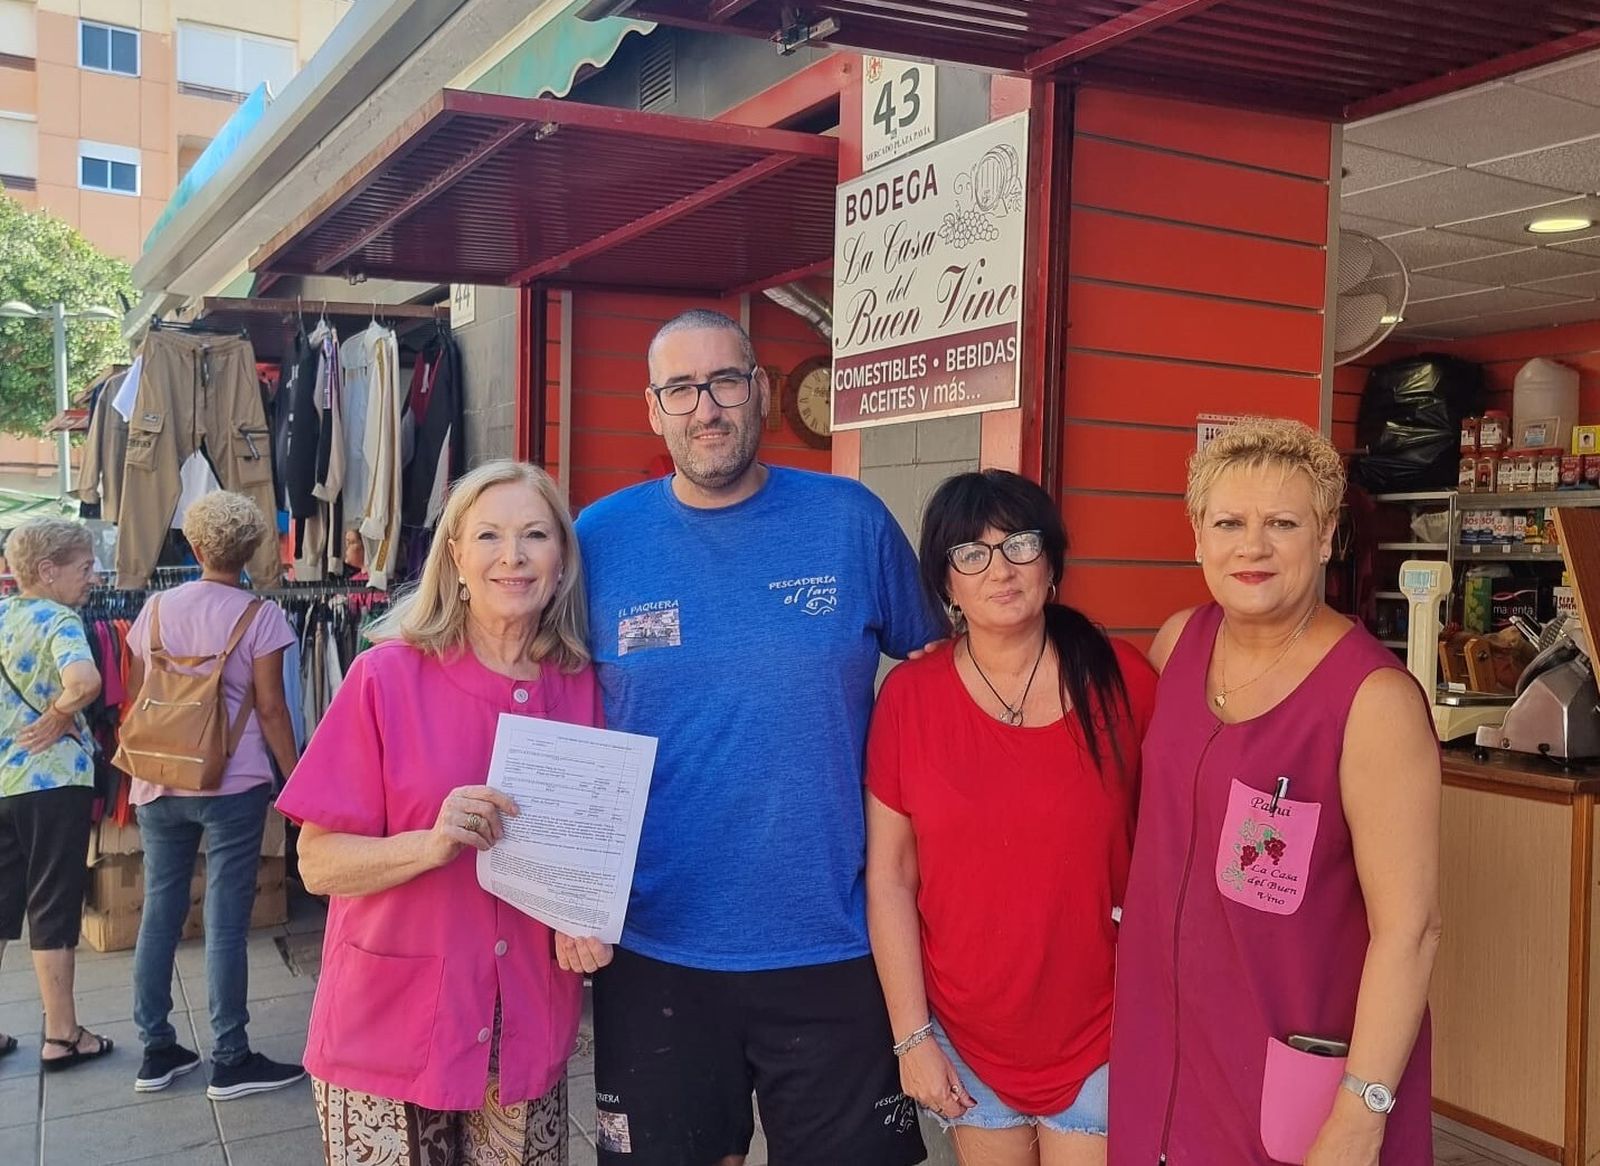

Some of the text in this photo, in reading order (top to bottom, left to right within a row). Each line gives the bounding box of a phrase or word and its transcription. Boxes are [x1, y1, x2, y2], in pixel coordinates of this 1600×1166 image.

[873, 67, 921, 136] 43
[845, 163, 938, 226] BODEGA
[839, 219, 936, 287] La Casa
[835, 257, 1018, 350] Buen Vino
[886, 267, 918, 304] del
[835, 336, 1016, 391] COMESTIBLES BEBIDAS
[859, 385, 915, 415] ACEITES
[920, 387, 930, 410] y
[933, 376, 981, 404] más...
[630, 599, 679, 615] PAQUERA
[784, 587, 805, 605] el
[1247, 876, 1297, 895] del Buen
[1251, 864, 1298, 882] La Casa
[1257, 891, 1285, 905] Vino
